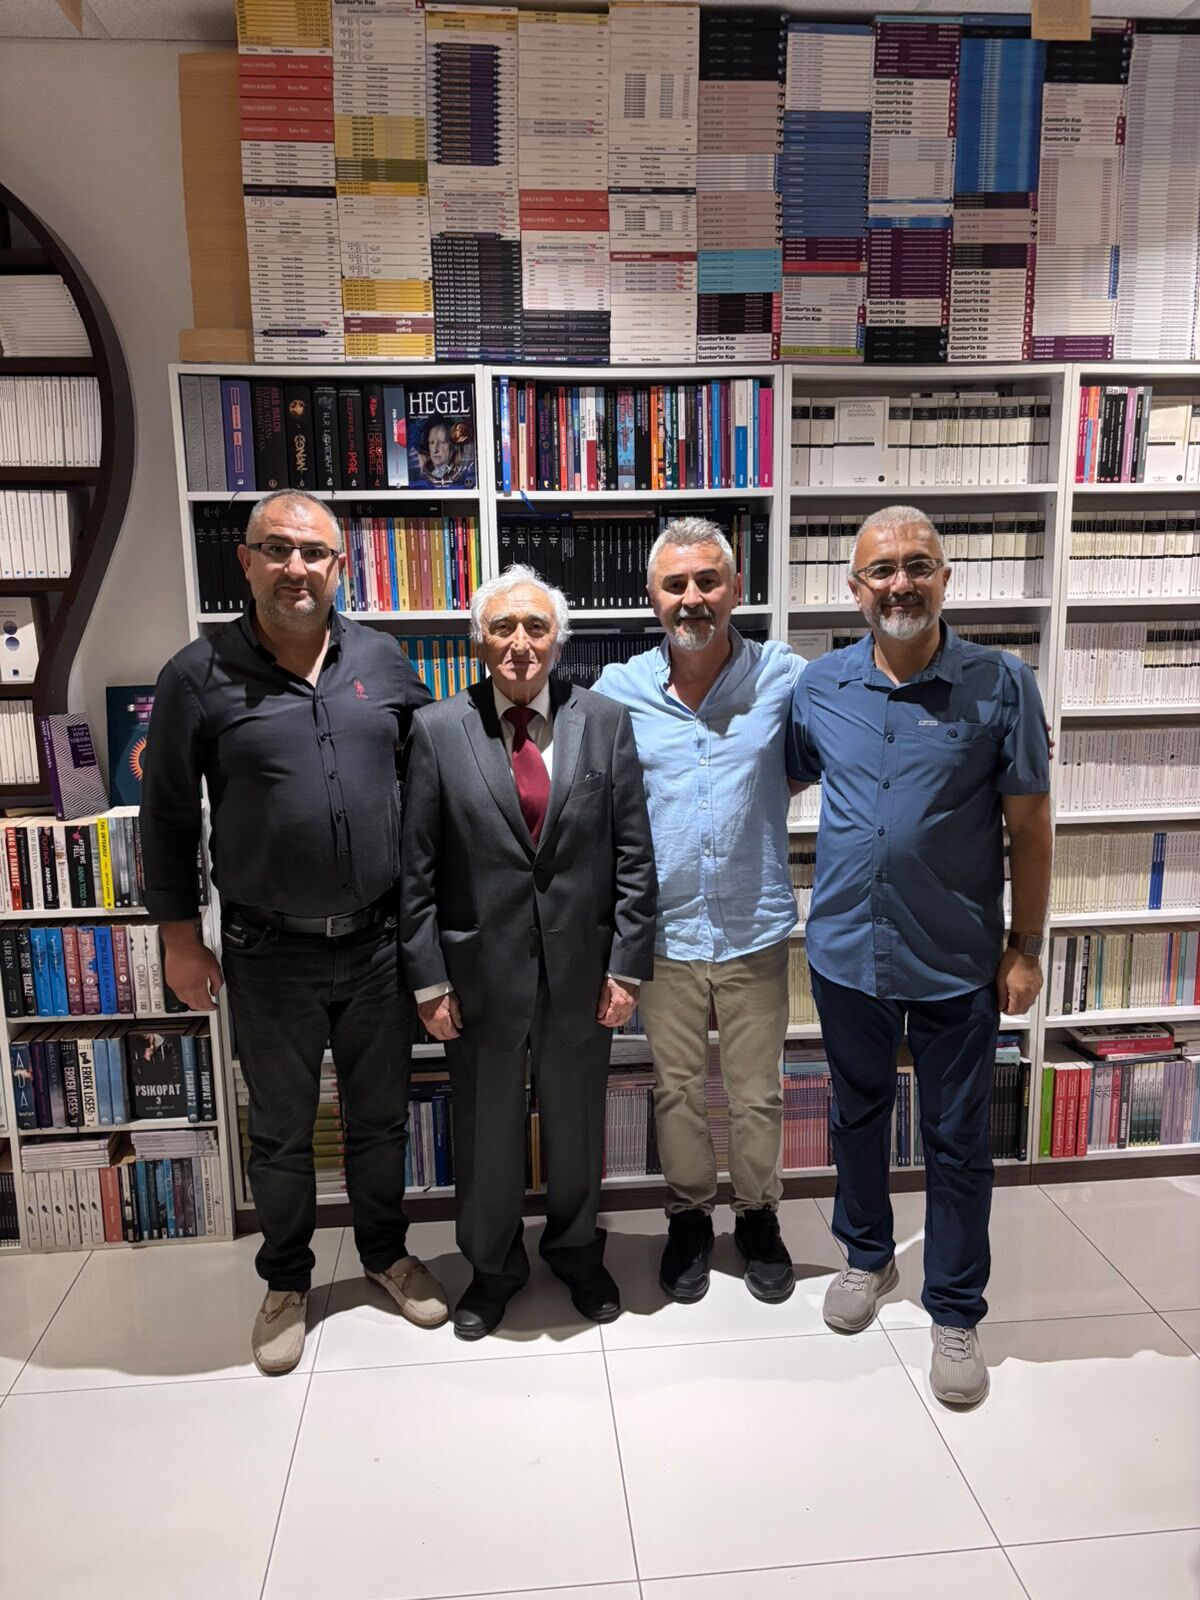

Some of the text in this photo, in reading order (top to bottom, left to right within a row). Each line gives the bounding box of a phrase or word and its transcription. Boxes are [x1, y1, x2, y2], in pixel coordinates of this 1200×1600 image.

[408, 390, 470, 414] HEGEL
[294, 435, 308, 473] CONAN
[347, 451, 358, 474] POE
[374, 433, 384, 475] GEORGE
[7, 829, 20, 887] KING OF RABBITS
[80, 856, 86, 864] WE
[77, 865, 87, 899] ANNA TODD
[3, 940, 13, 969] SİREN
[136, 964, 148, 990] ÇIRAK
[150, 964, 163, 989] ÇIRAK
[64, 1067, 76, 1091] ERKEK
[82, 1066, 93, 1090] ERKEK
[135, 1082, 181, 1097] PSİKOPAT
[185, 1071, 196, 1100] PSİKOPAT
[201, 1071, 211, 1100] PSİKOPAT
[156, 1096, 162, 1105] 3
